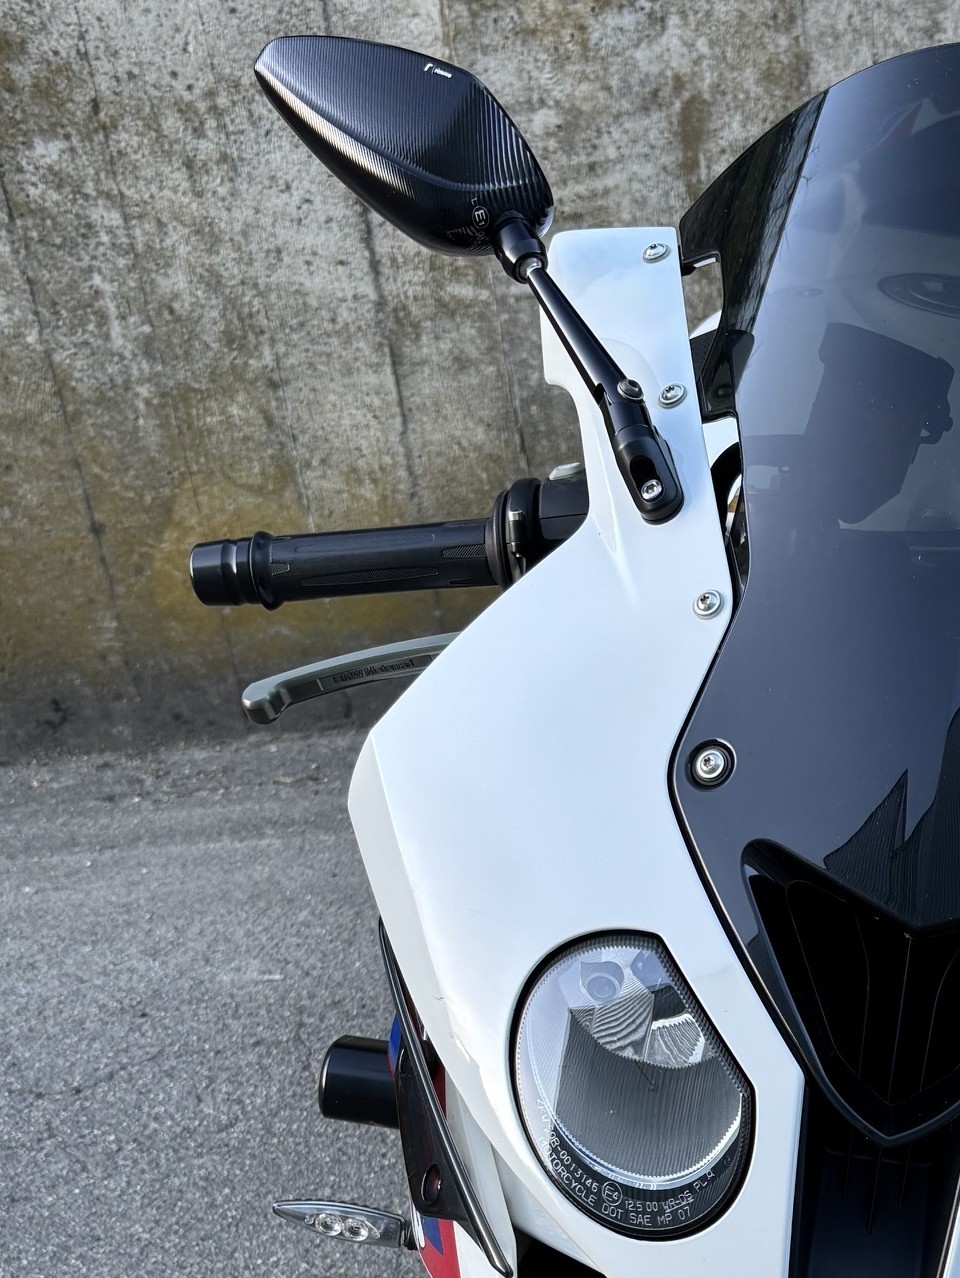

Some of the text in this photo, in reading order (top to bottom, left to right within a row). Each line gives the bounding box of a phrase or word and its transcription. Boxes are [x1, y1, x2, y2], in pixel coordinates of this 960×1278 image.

[538, 1136, 691, 1226] MOTORCYCLE DOT SAE MP 07
[693, 1179, 708, 1192] PL
